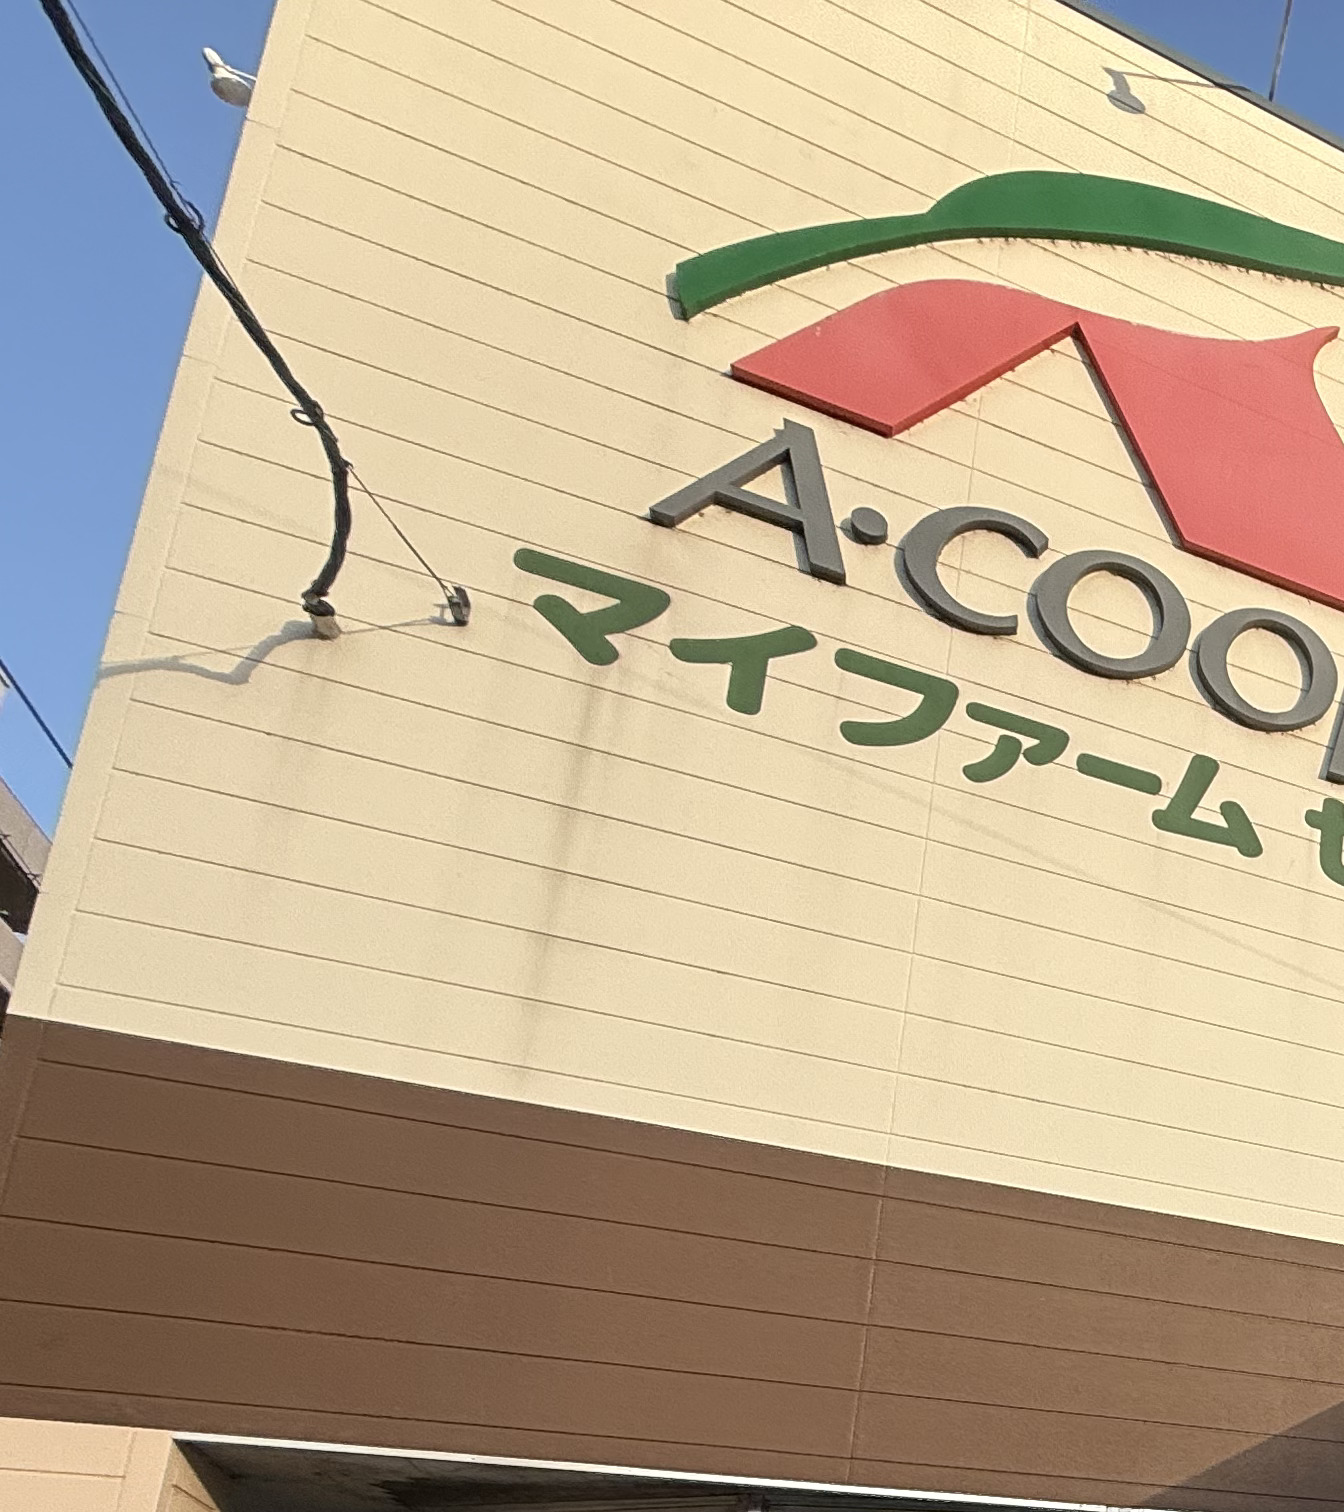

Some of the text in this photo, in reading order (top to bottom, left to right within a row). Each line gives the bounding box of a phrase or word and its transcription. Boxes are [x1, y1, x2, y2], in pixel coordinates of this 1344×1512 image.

[513, 547, 1263, 859] マイファーム
